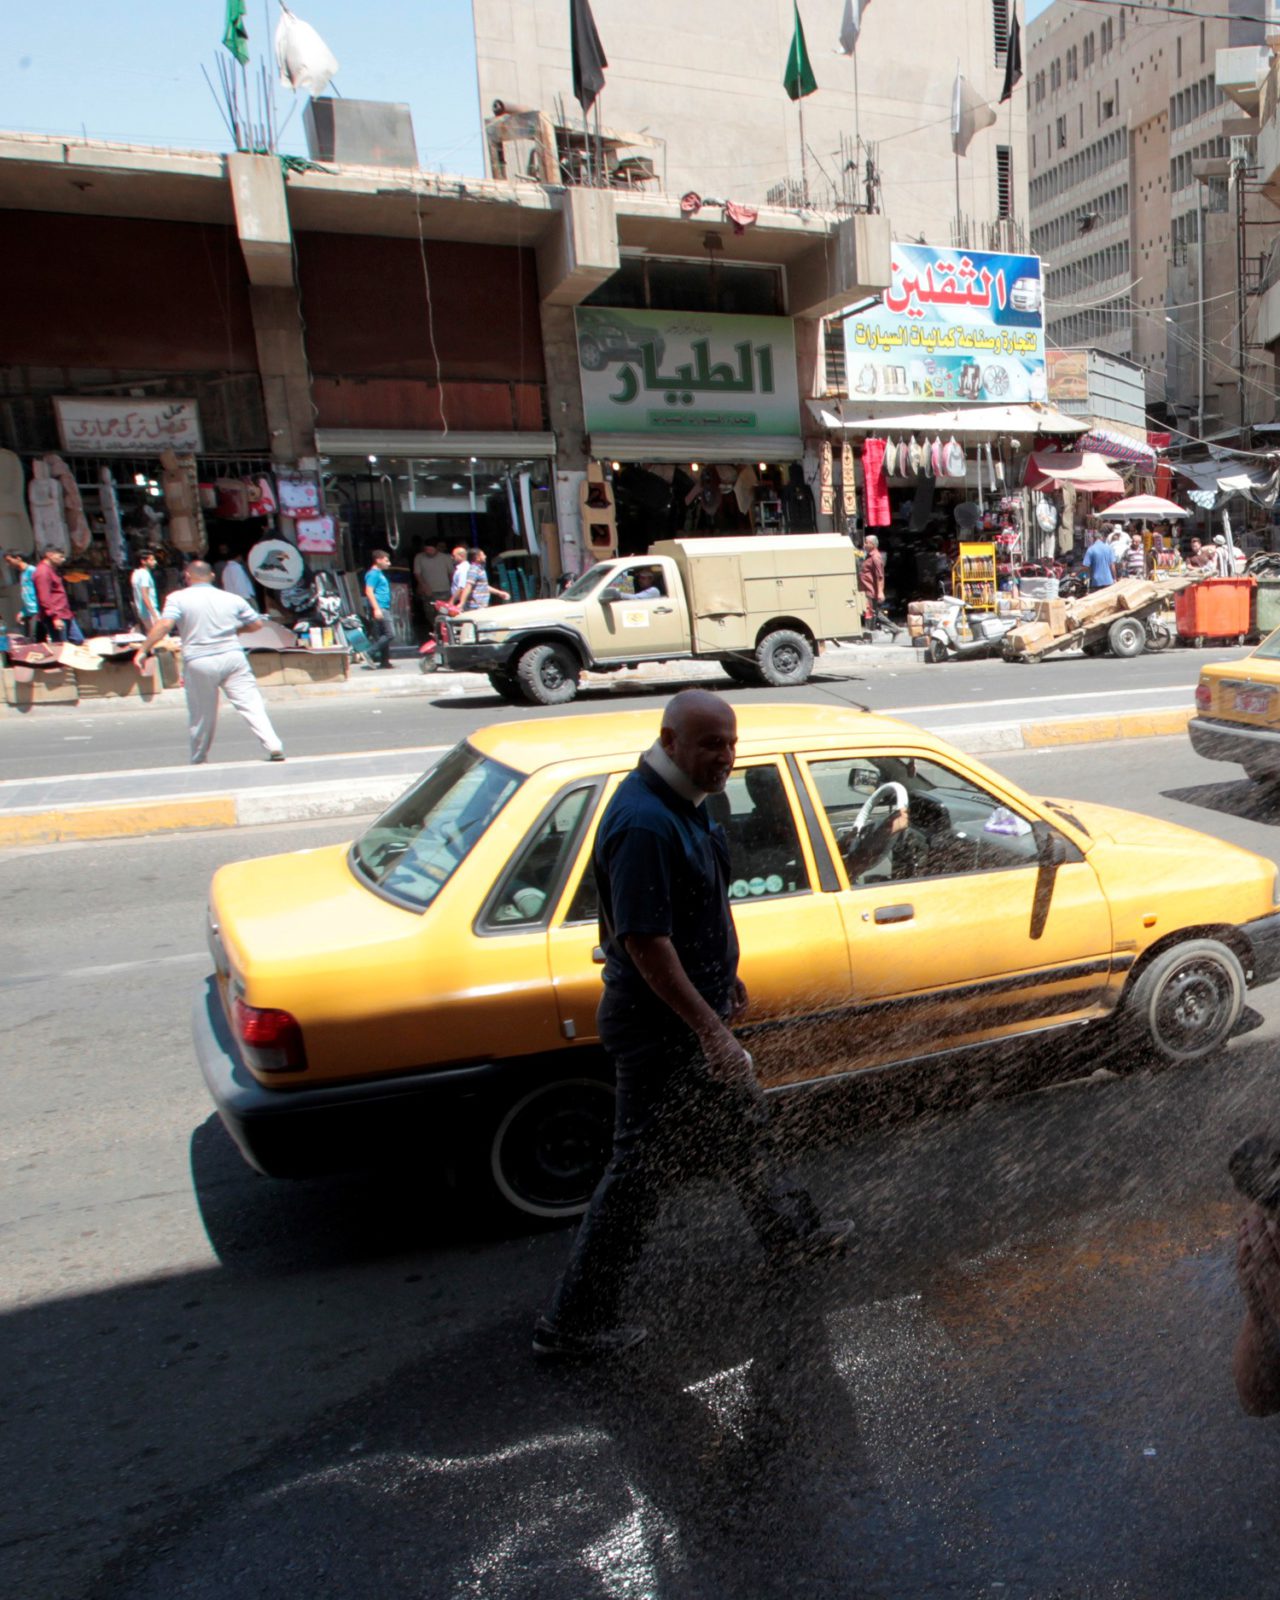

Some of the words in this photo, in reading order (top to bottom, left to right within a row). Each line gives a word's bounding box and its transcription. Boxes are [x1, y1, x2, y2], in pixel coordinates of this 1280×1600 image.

[885, 255, 1007, 319] الثقلين
[854, 322, 908, 351] السيارات
[909, 324, 957, 353] كماليات
[958, 326, 1001, 356] وصناعة
[1000, 328, 1038, 357] لتجارة
[608, 336, 776, 406] الطيار
